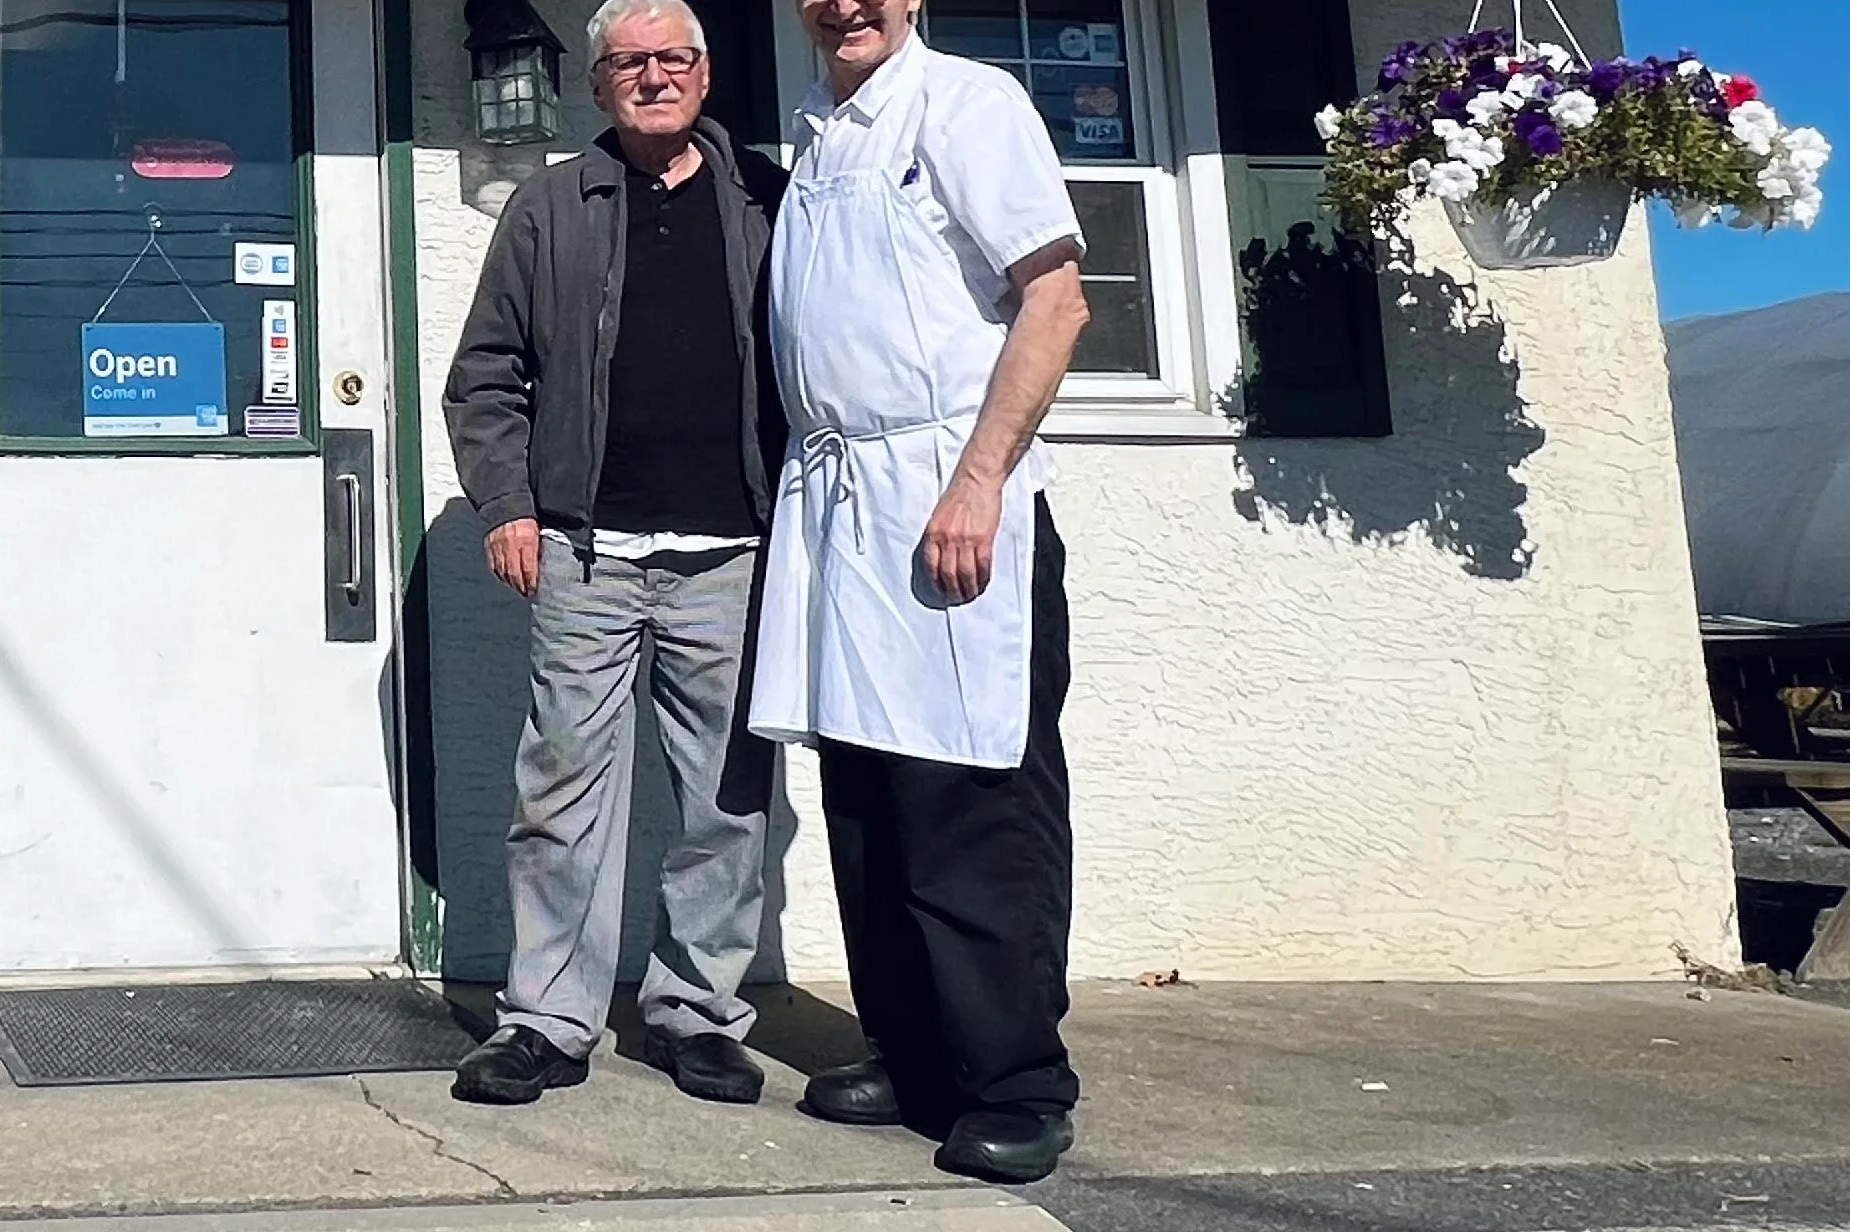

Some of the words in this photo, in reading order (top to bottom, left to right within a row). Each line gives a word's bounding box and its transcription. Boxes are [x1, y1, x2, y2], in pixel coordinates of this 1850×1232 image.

[1080, 123, 1121, 139] VISA
[89, 348, 177, 384] Open
[91, 384, 137, 400] Come
[141, 387, 156, 400] in
